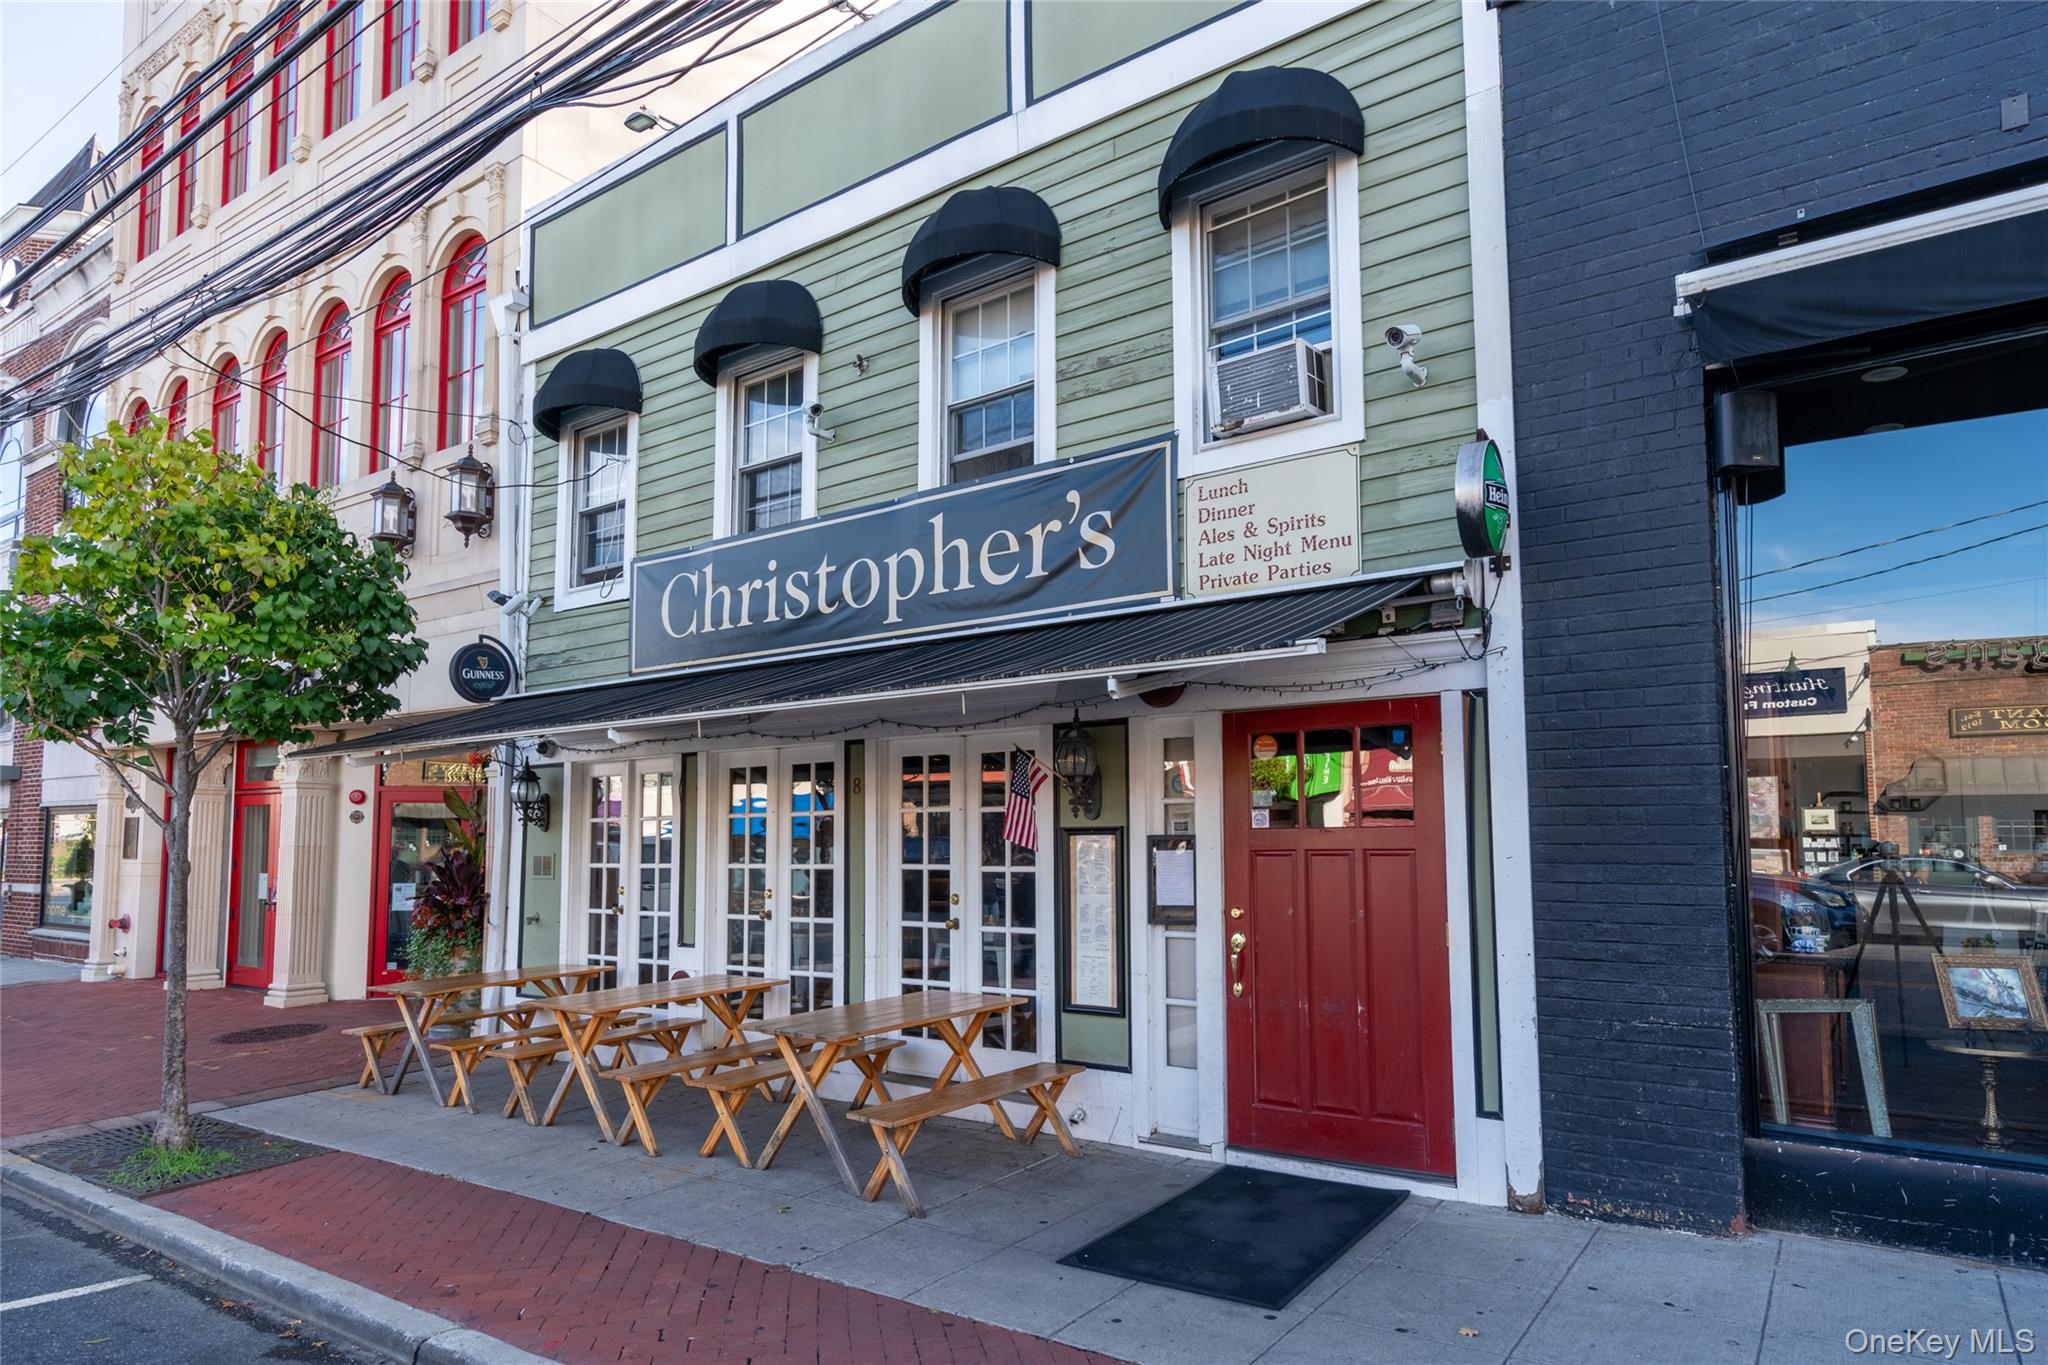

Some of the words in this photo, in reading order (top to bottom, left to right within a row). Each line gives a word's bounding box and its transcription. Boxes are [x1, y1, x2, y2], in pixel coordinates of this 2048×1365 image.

[1198, 479, 1249, 502] Lunch
[1198, 503, 1256, 524] Dinner
[1198, 528, 1235, 547] Ales
[1243, 521, 1259, 538] &
[1267, 513, 1326, 537] Spirits
[661, 489, 1117, 638] Christopher's
[1198, 551, 1236, 569] Late
[1243, 541, 1292, 564] Night
[1301, 533, 1353, 553] Menu
[1199, 571, 1259, 591] Private
[1267, 560, 1332, 581] Parties
[462, 668, 505, 680] GUINNESS
[852, 777, 862, 795] 8
